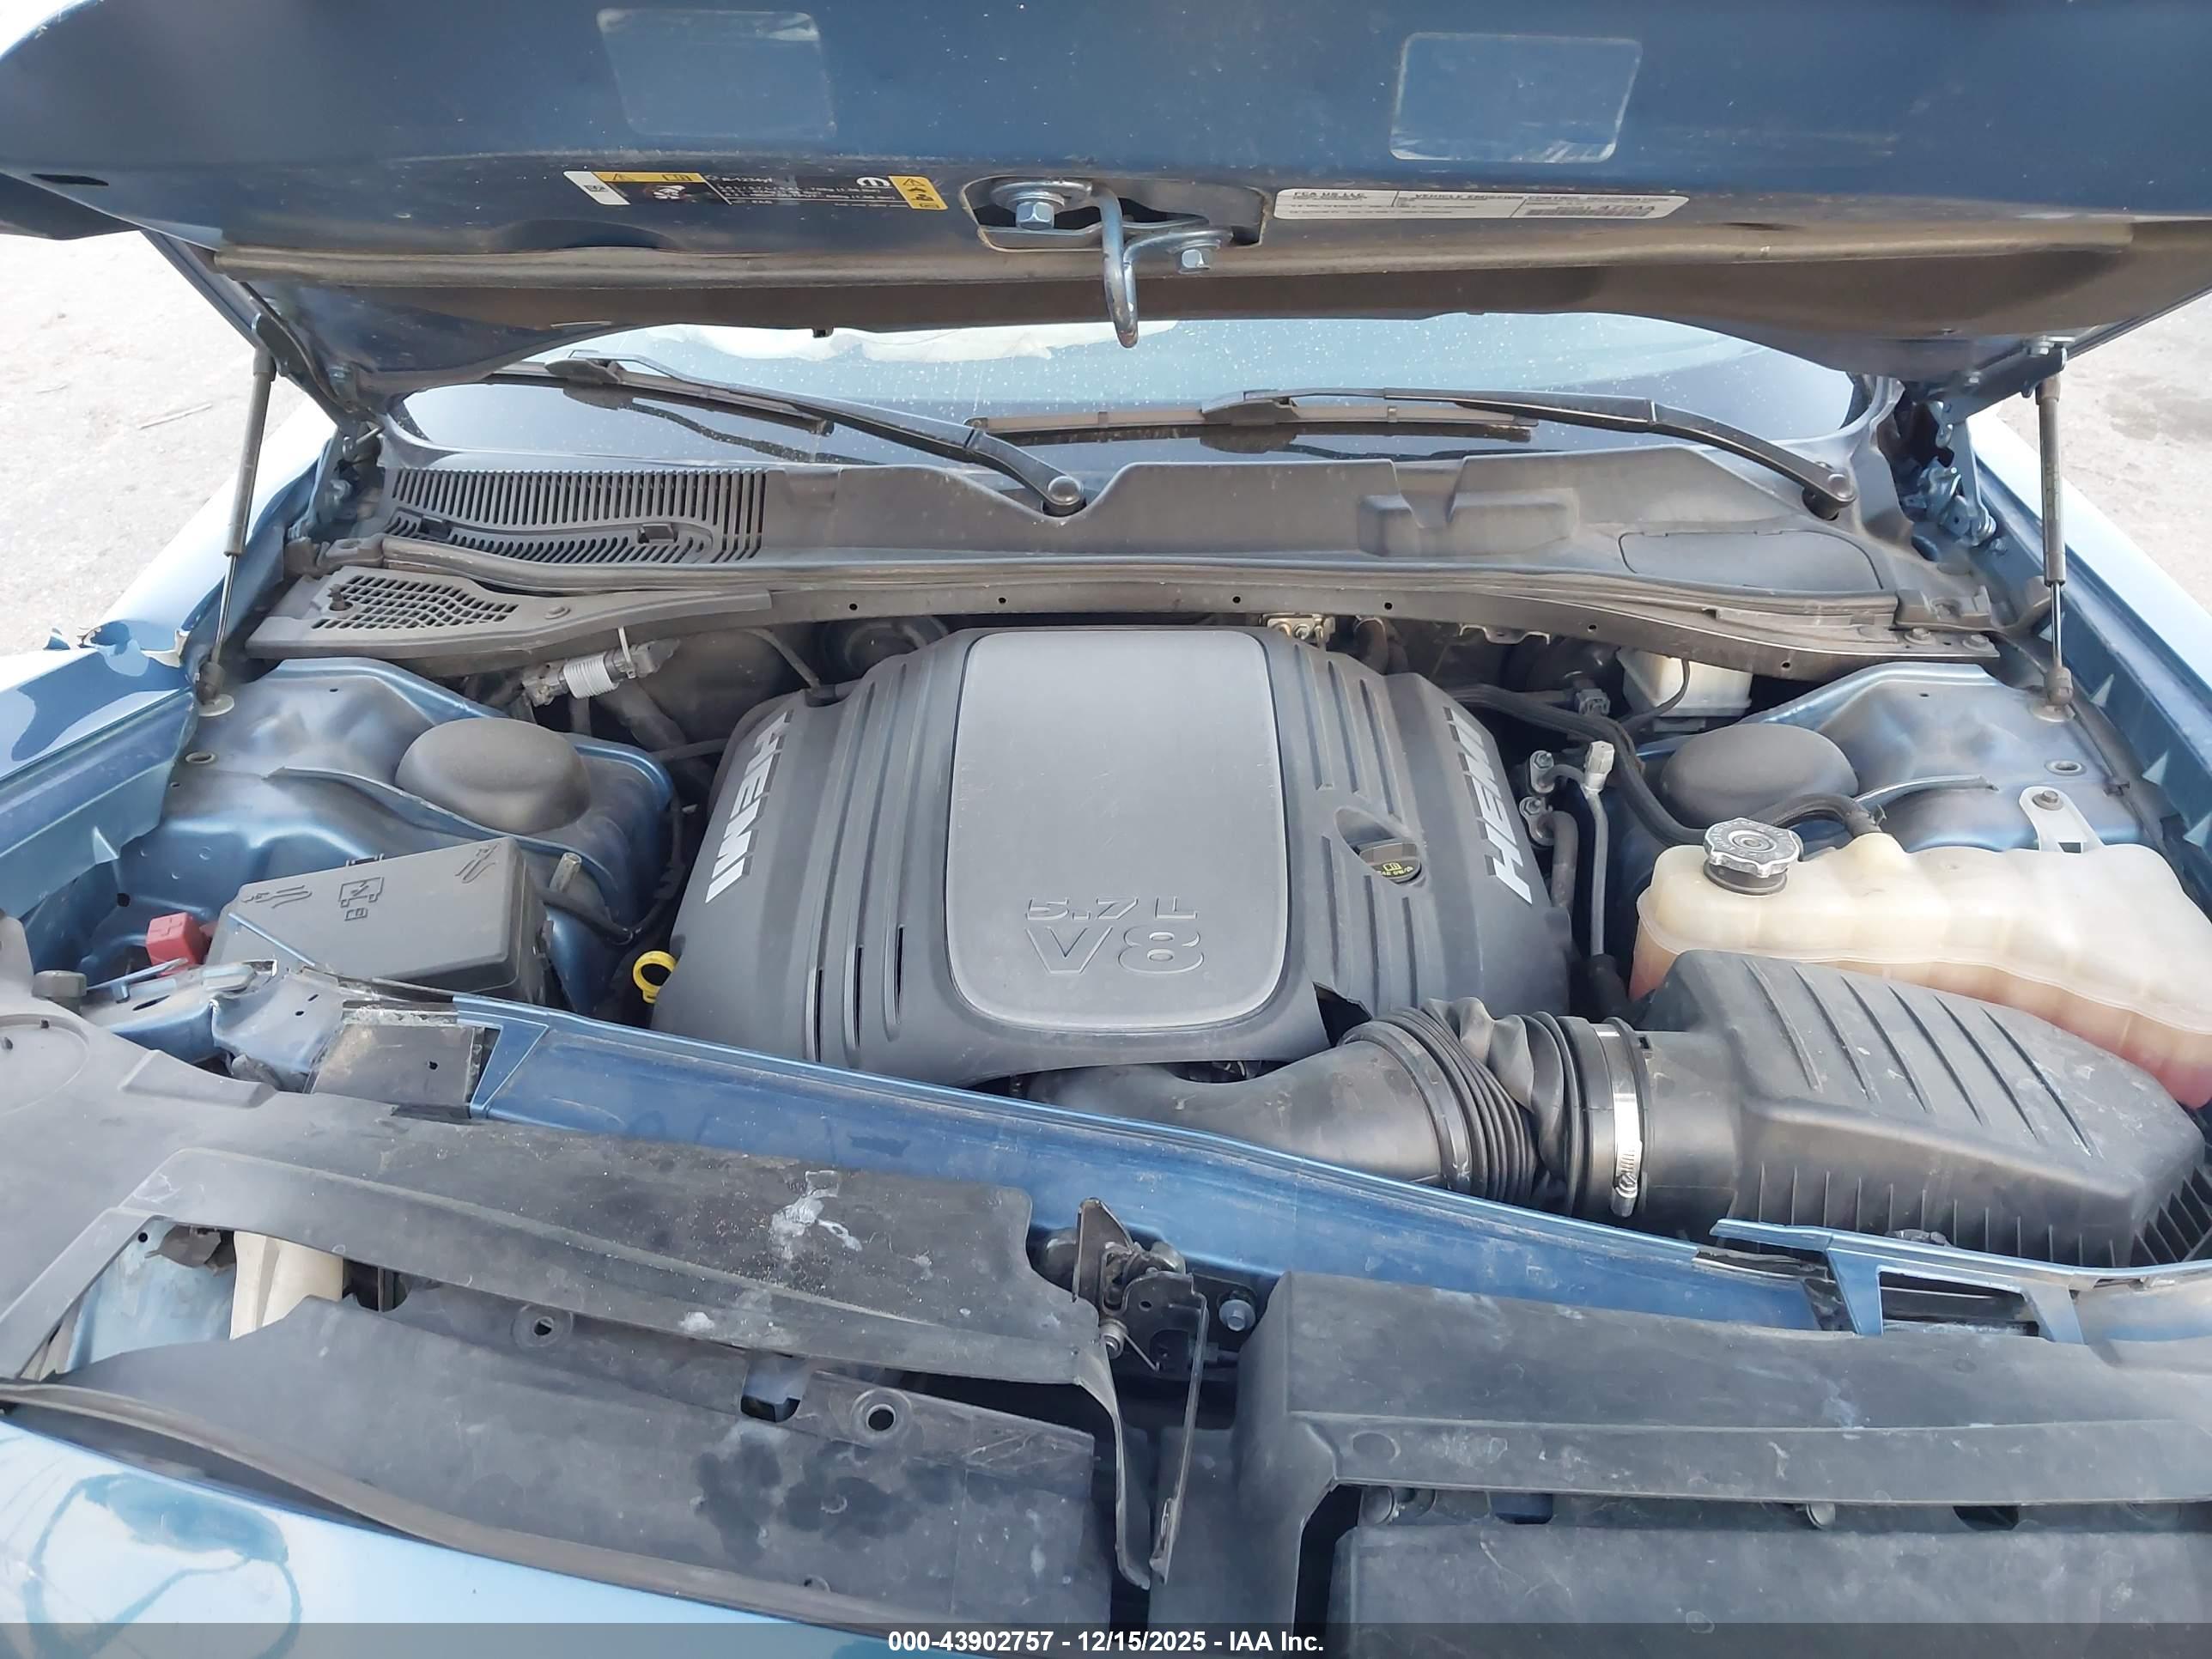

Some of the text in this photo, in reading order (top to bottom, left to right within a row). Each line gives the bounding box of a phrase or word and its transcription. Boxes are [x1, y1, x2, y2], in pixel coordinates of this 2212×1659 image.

[704, 709, 792, 904] HEMI
[1445, 708, 1533, 905] HEMI
[1024, 924, 1205, 975] V8
